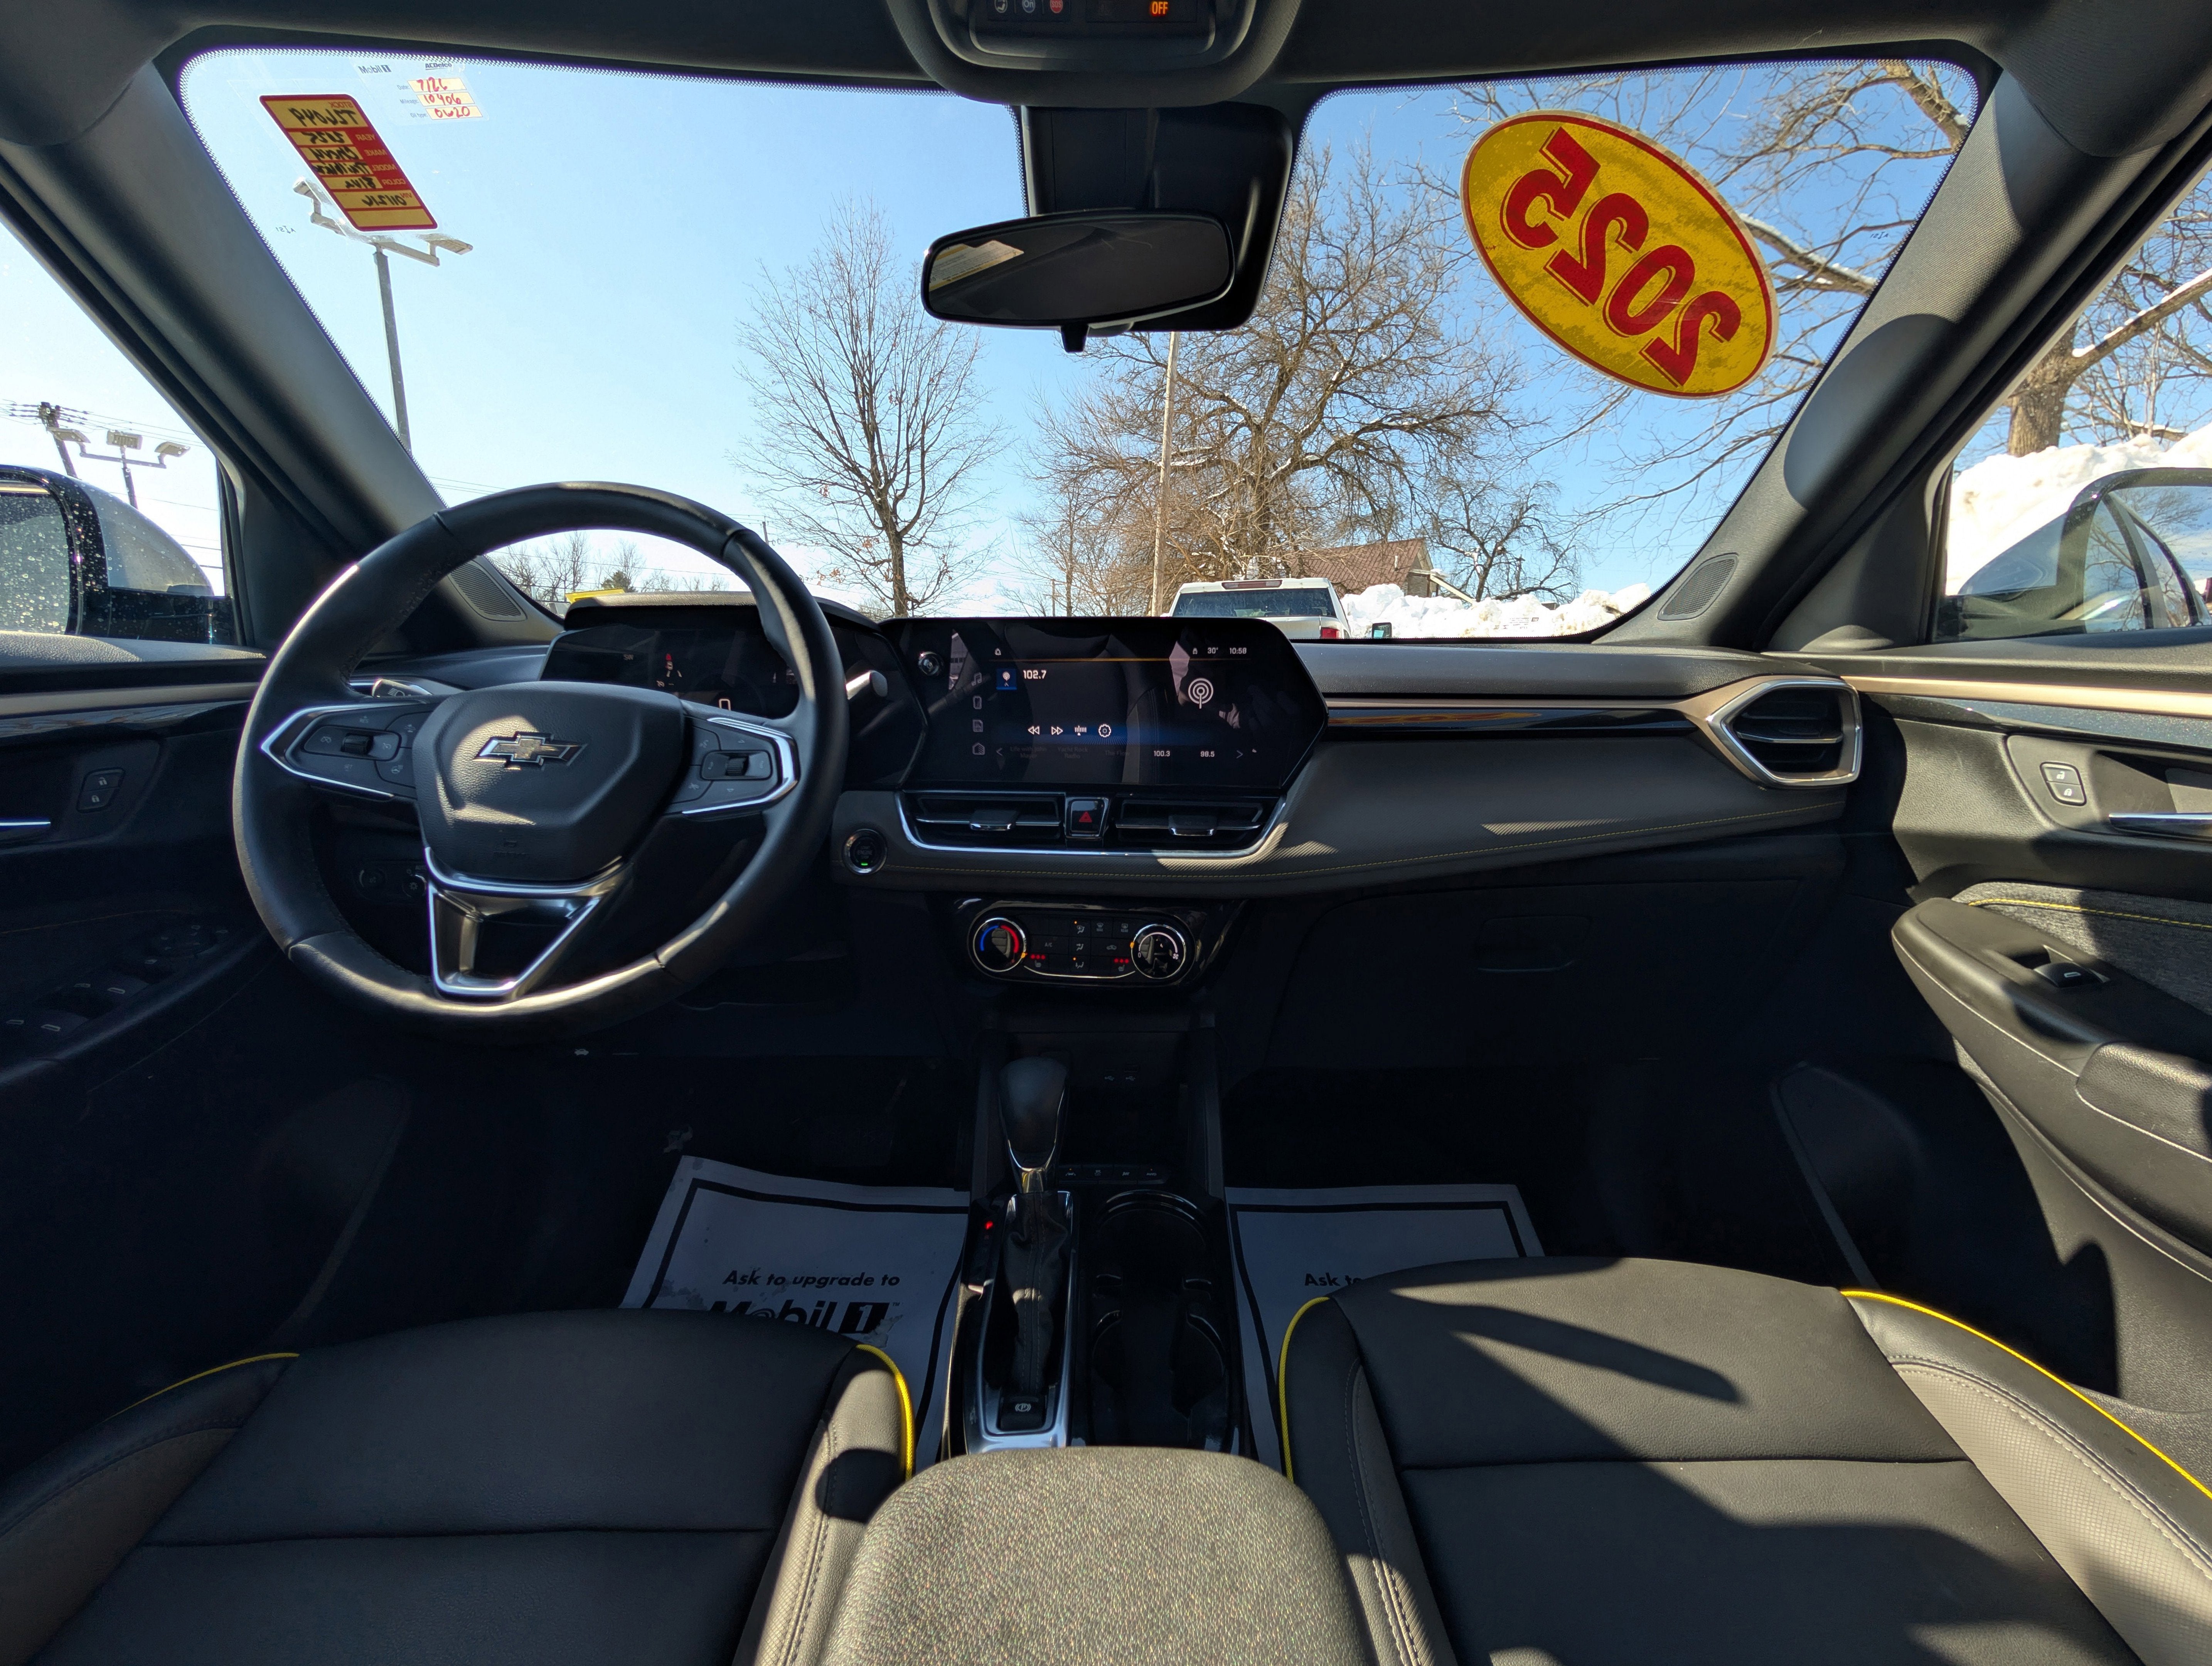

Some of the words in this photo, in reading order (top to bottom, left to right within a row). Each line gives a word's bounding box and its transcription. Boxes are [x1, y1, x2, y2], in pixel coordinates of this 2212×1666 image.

[1050, 0, 1062, 8] SOS
[1152, 1, 1168, 14] OFF
[358, 65, 382, 74] Mobil
[1023, 669, 1046, 680] 102.7
[723, 1270, 761, 1285] Ask
[767, 1273, 786, 1285] to
[792, 1272, 874, 1288] upgrade
[881, 1273, 900, 1286] to
[1304, 1273, 1340, 1286] Ask
